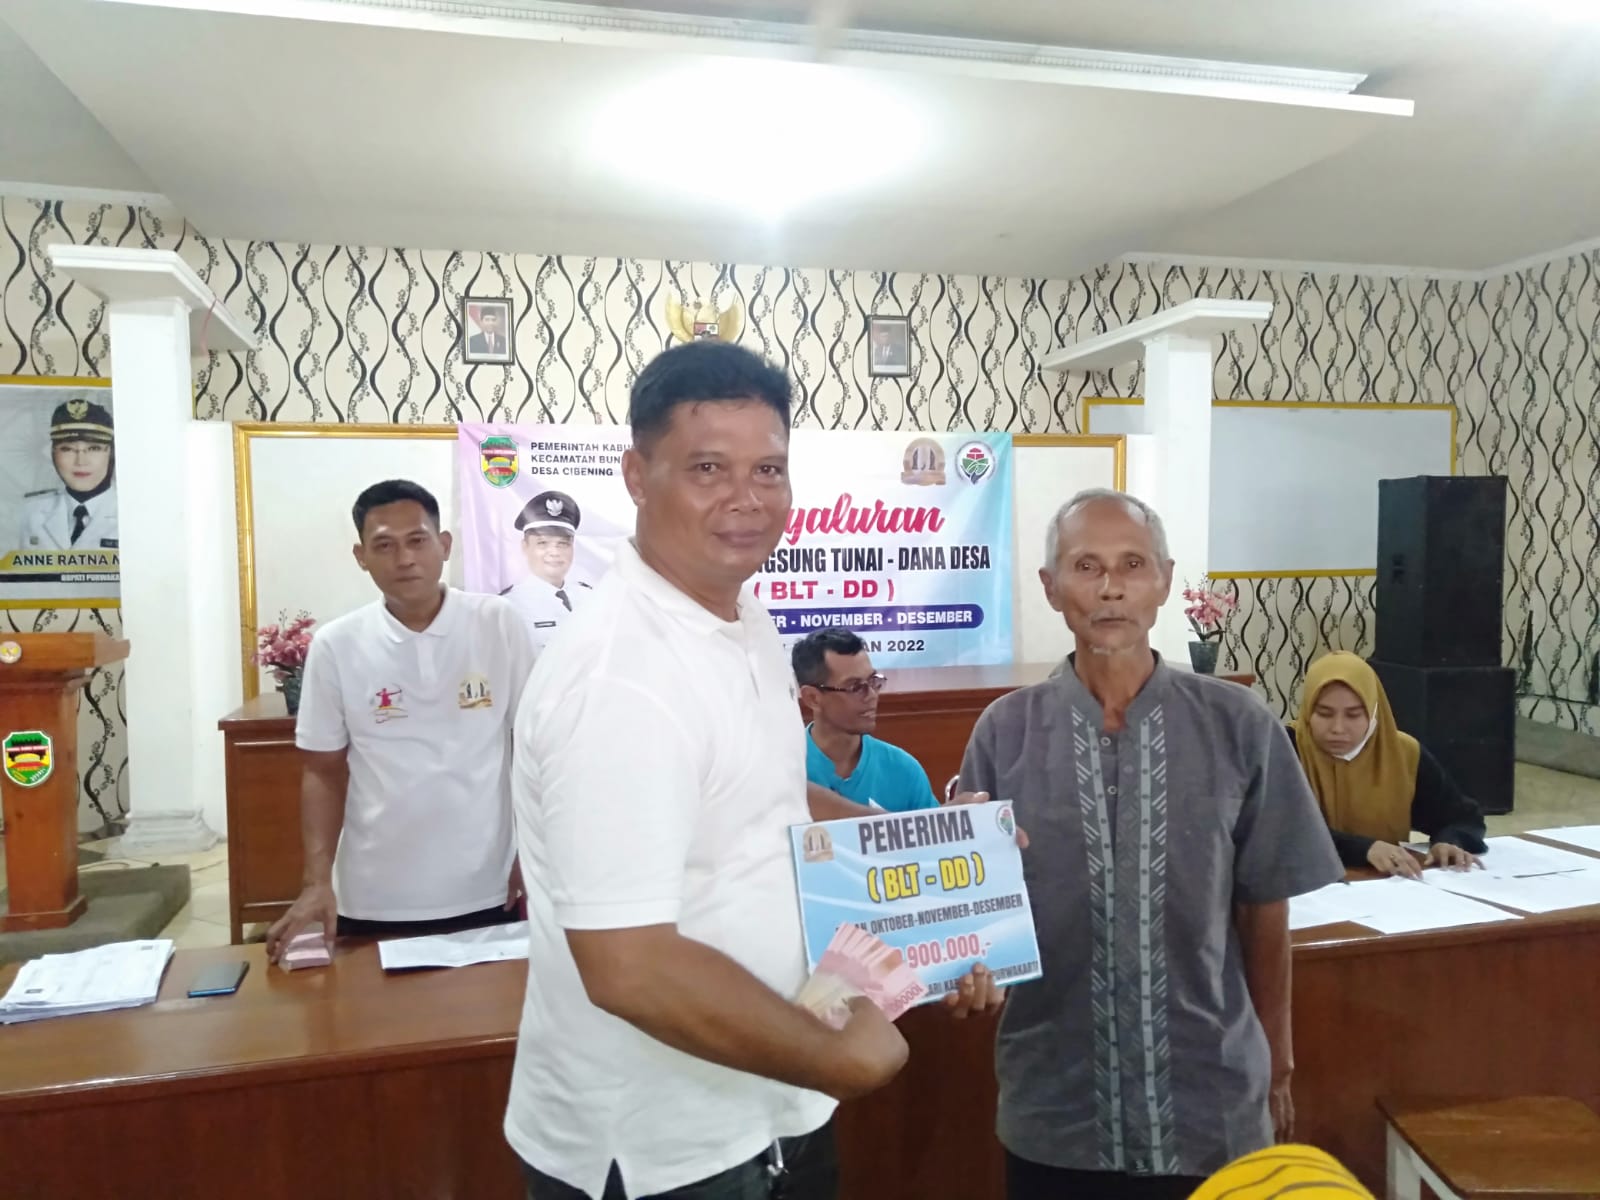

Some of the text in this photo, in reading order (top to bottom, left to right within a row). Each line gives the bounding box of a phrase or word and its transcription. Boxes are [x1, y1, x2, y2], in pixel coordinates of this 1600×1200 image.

[531, 442, 634, 452] PEMERINTAH KABU
[531, 455, 621, 464] KECAMATAN BUN
[531, 467, 613, 476] DESA CIBENING
[784, 492, 945, 546] yaluran
[12, 554, 53, 566] ANNE
[57, 554, 108, 566] RATNA
[758, 547, 826, 573] GSUNG
[830, 547, 883, 572] TUNAI
[898, 547, 946, 570] DANA
[950, 545, 991, 569] DESA
[771, 581, 818, 600] BLT
[843, 579, 878, 599] DD
[800, 613, 883, 627] NOVEMBER
[897, 610, 973, 624] DESEMBER
[864, 640, 925, 652] AN 2022
[858, 810, 975, 855] PENERIMA
[882, 863, 920, 901] BLT
[939, 856, 970, 891] DD
